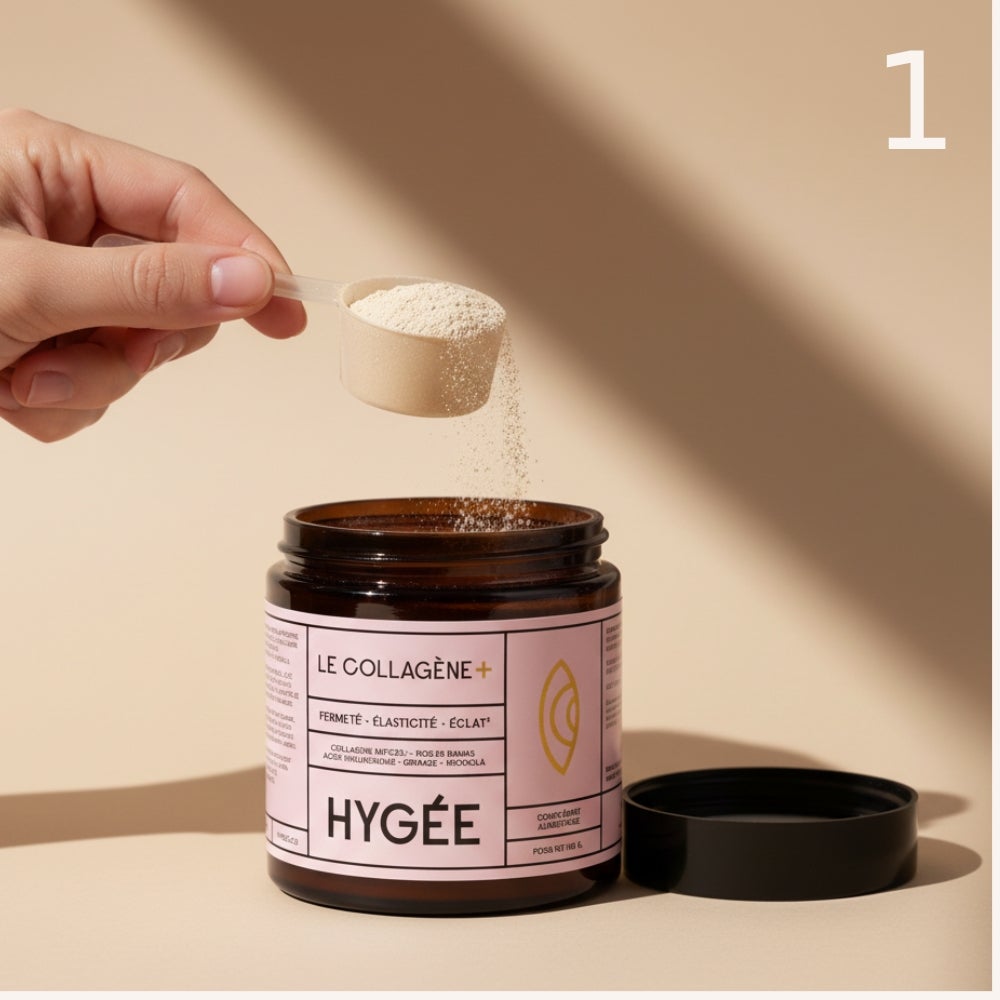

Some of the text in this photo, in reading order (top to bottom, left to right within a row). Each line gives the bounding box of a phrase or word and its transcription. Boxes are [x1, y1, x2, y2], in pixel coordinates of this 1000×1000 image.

[317, 654, 337, 675] LE
[319, 710, 363, 725] FERMETÉ
[372, 716, 438, 729] ÉLASTICITÉ
[328, 794, 480, 845] HYGÉE
